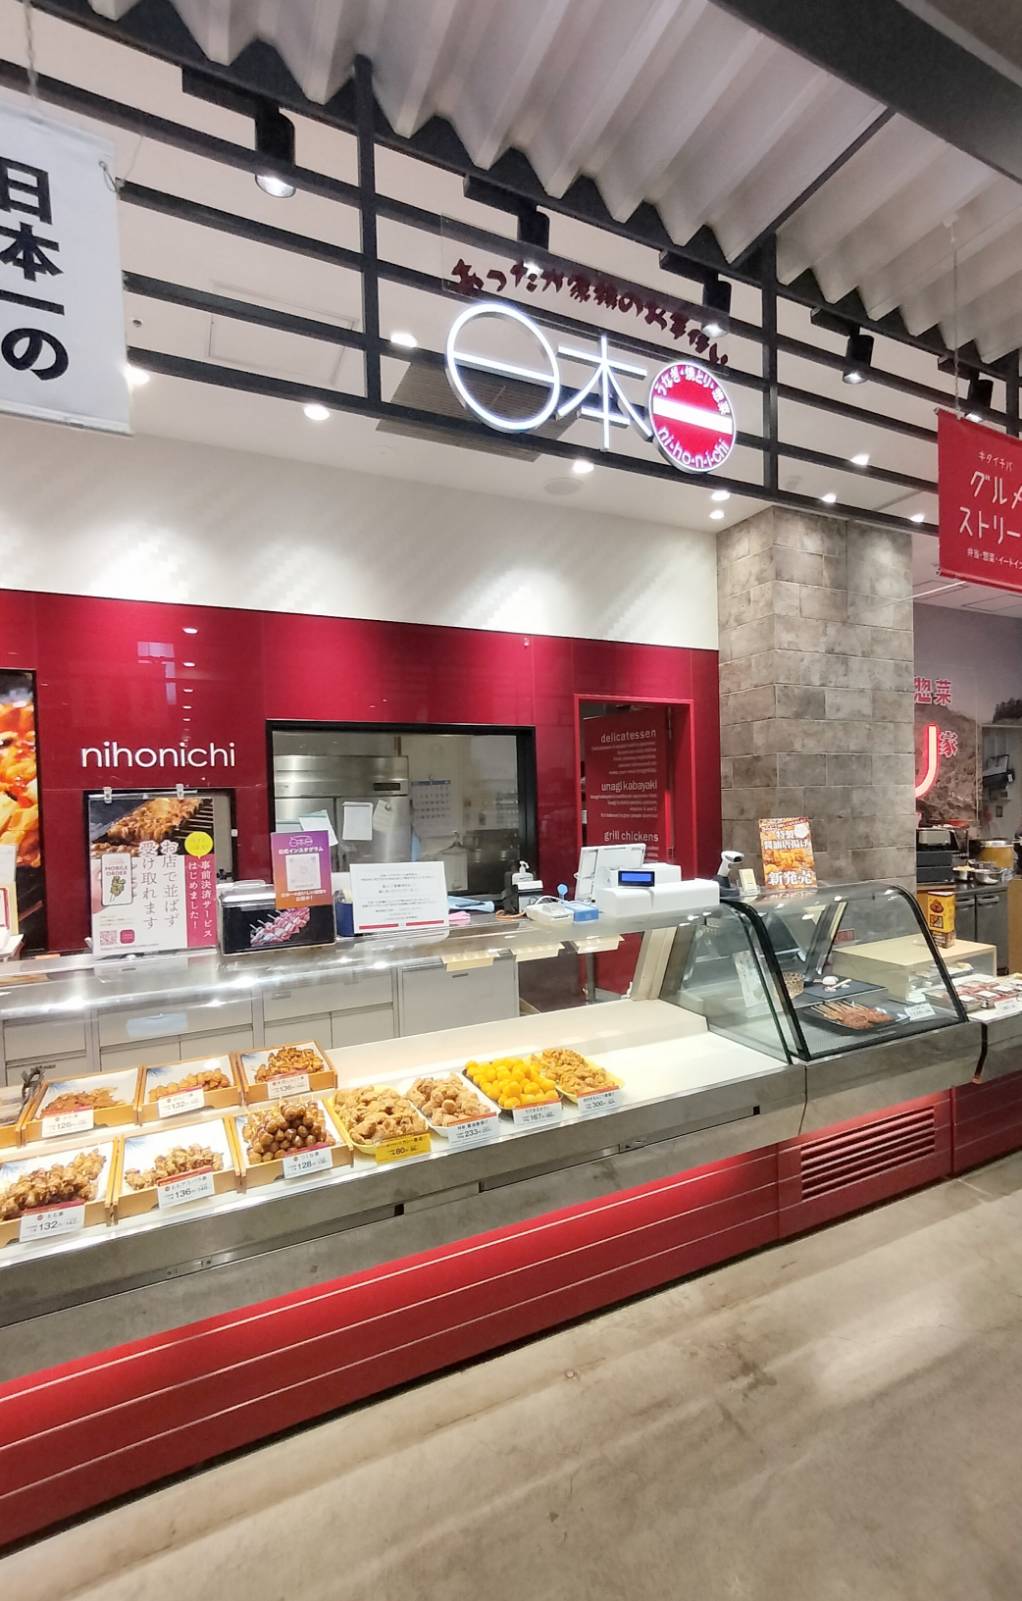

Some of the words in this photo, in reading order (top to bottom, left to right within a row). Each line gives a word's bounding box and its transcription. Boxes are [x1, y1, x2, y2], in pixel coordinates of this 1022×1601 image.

[0, 156, 69, 381] 日本一の
[601, 729, 656, 744] delicatessen
[81, 741, 236, 768] nihonichi
[601, 781, 622, 794] unagi
[623, 780, 657, 793] kabayaki
[604, 830, 620, 842] grill
[621, 831, 659, 842] chickens
[141, 842, 158, 930] 受け取れます
[162, 841, 179, 930] お店で並ばず
[768, 870, 813, 886] 新発売
[200, 861, 213, 938] 事前決済サービス
[174, 1188, 192, 1199] 136
[39, 1220, 58, 1231] 132
